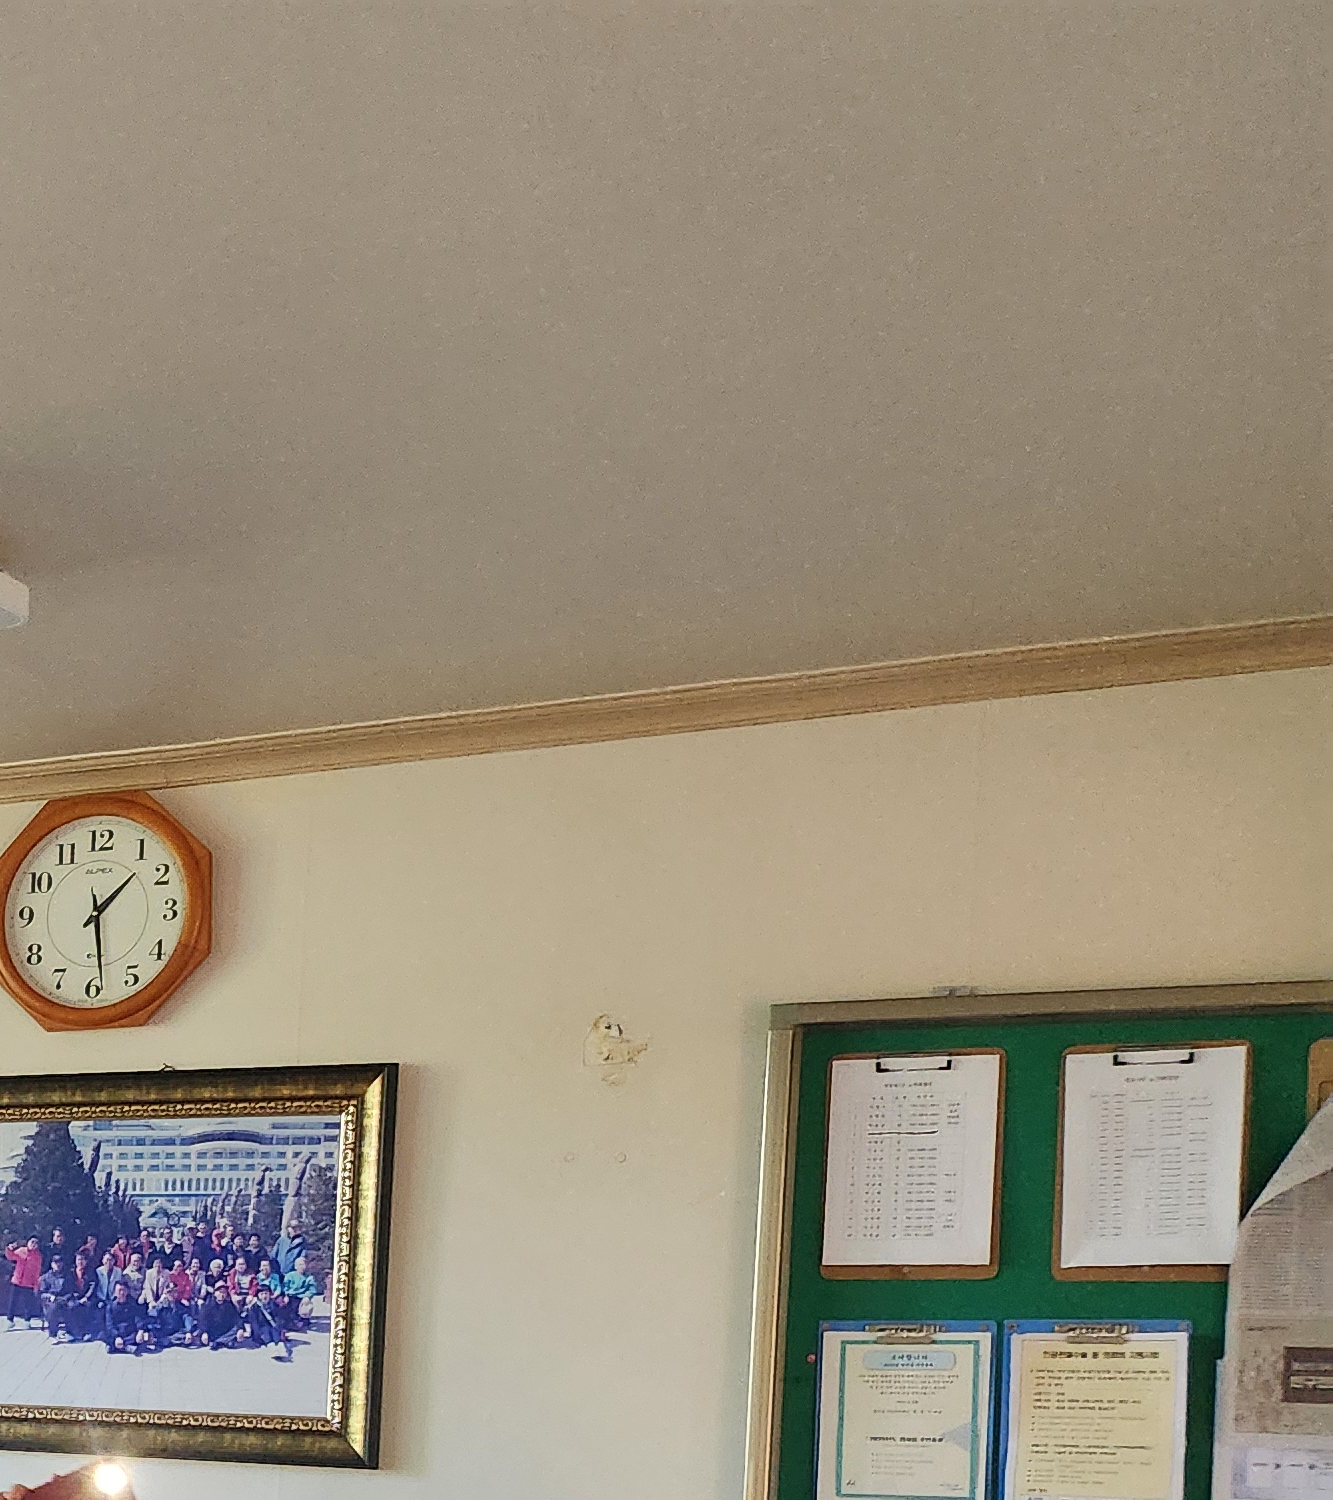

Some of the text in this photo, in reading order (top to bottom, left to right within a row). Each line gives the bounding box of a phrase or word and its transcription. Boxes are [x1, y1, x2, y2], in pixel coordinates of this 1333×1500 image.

[87, 829, 114, 852] 12
[135, 838, 147, 861] 1
[55, 843, 78, 866] 11
[27, 872, 52, 894] 10
[154, 864, 169, 885] 2
[19, 906, 34, 928] 9
[163, 898, 178, 921] 3
[27, 943, 42, 965] 8
[149, 939, 165, 961] 4
[52, 968, 67, 990] 7
[124, 964, 139, 987] 5
[85, 977, 101, 998] 6
